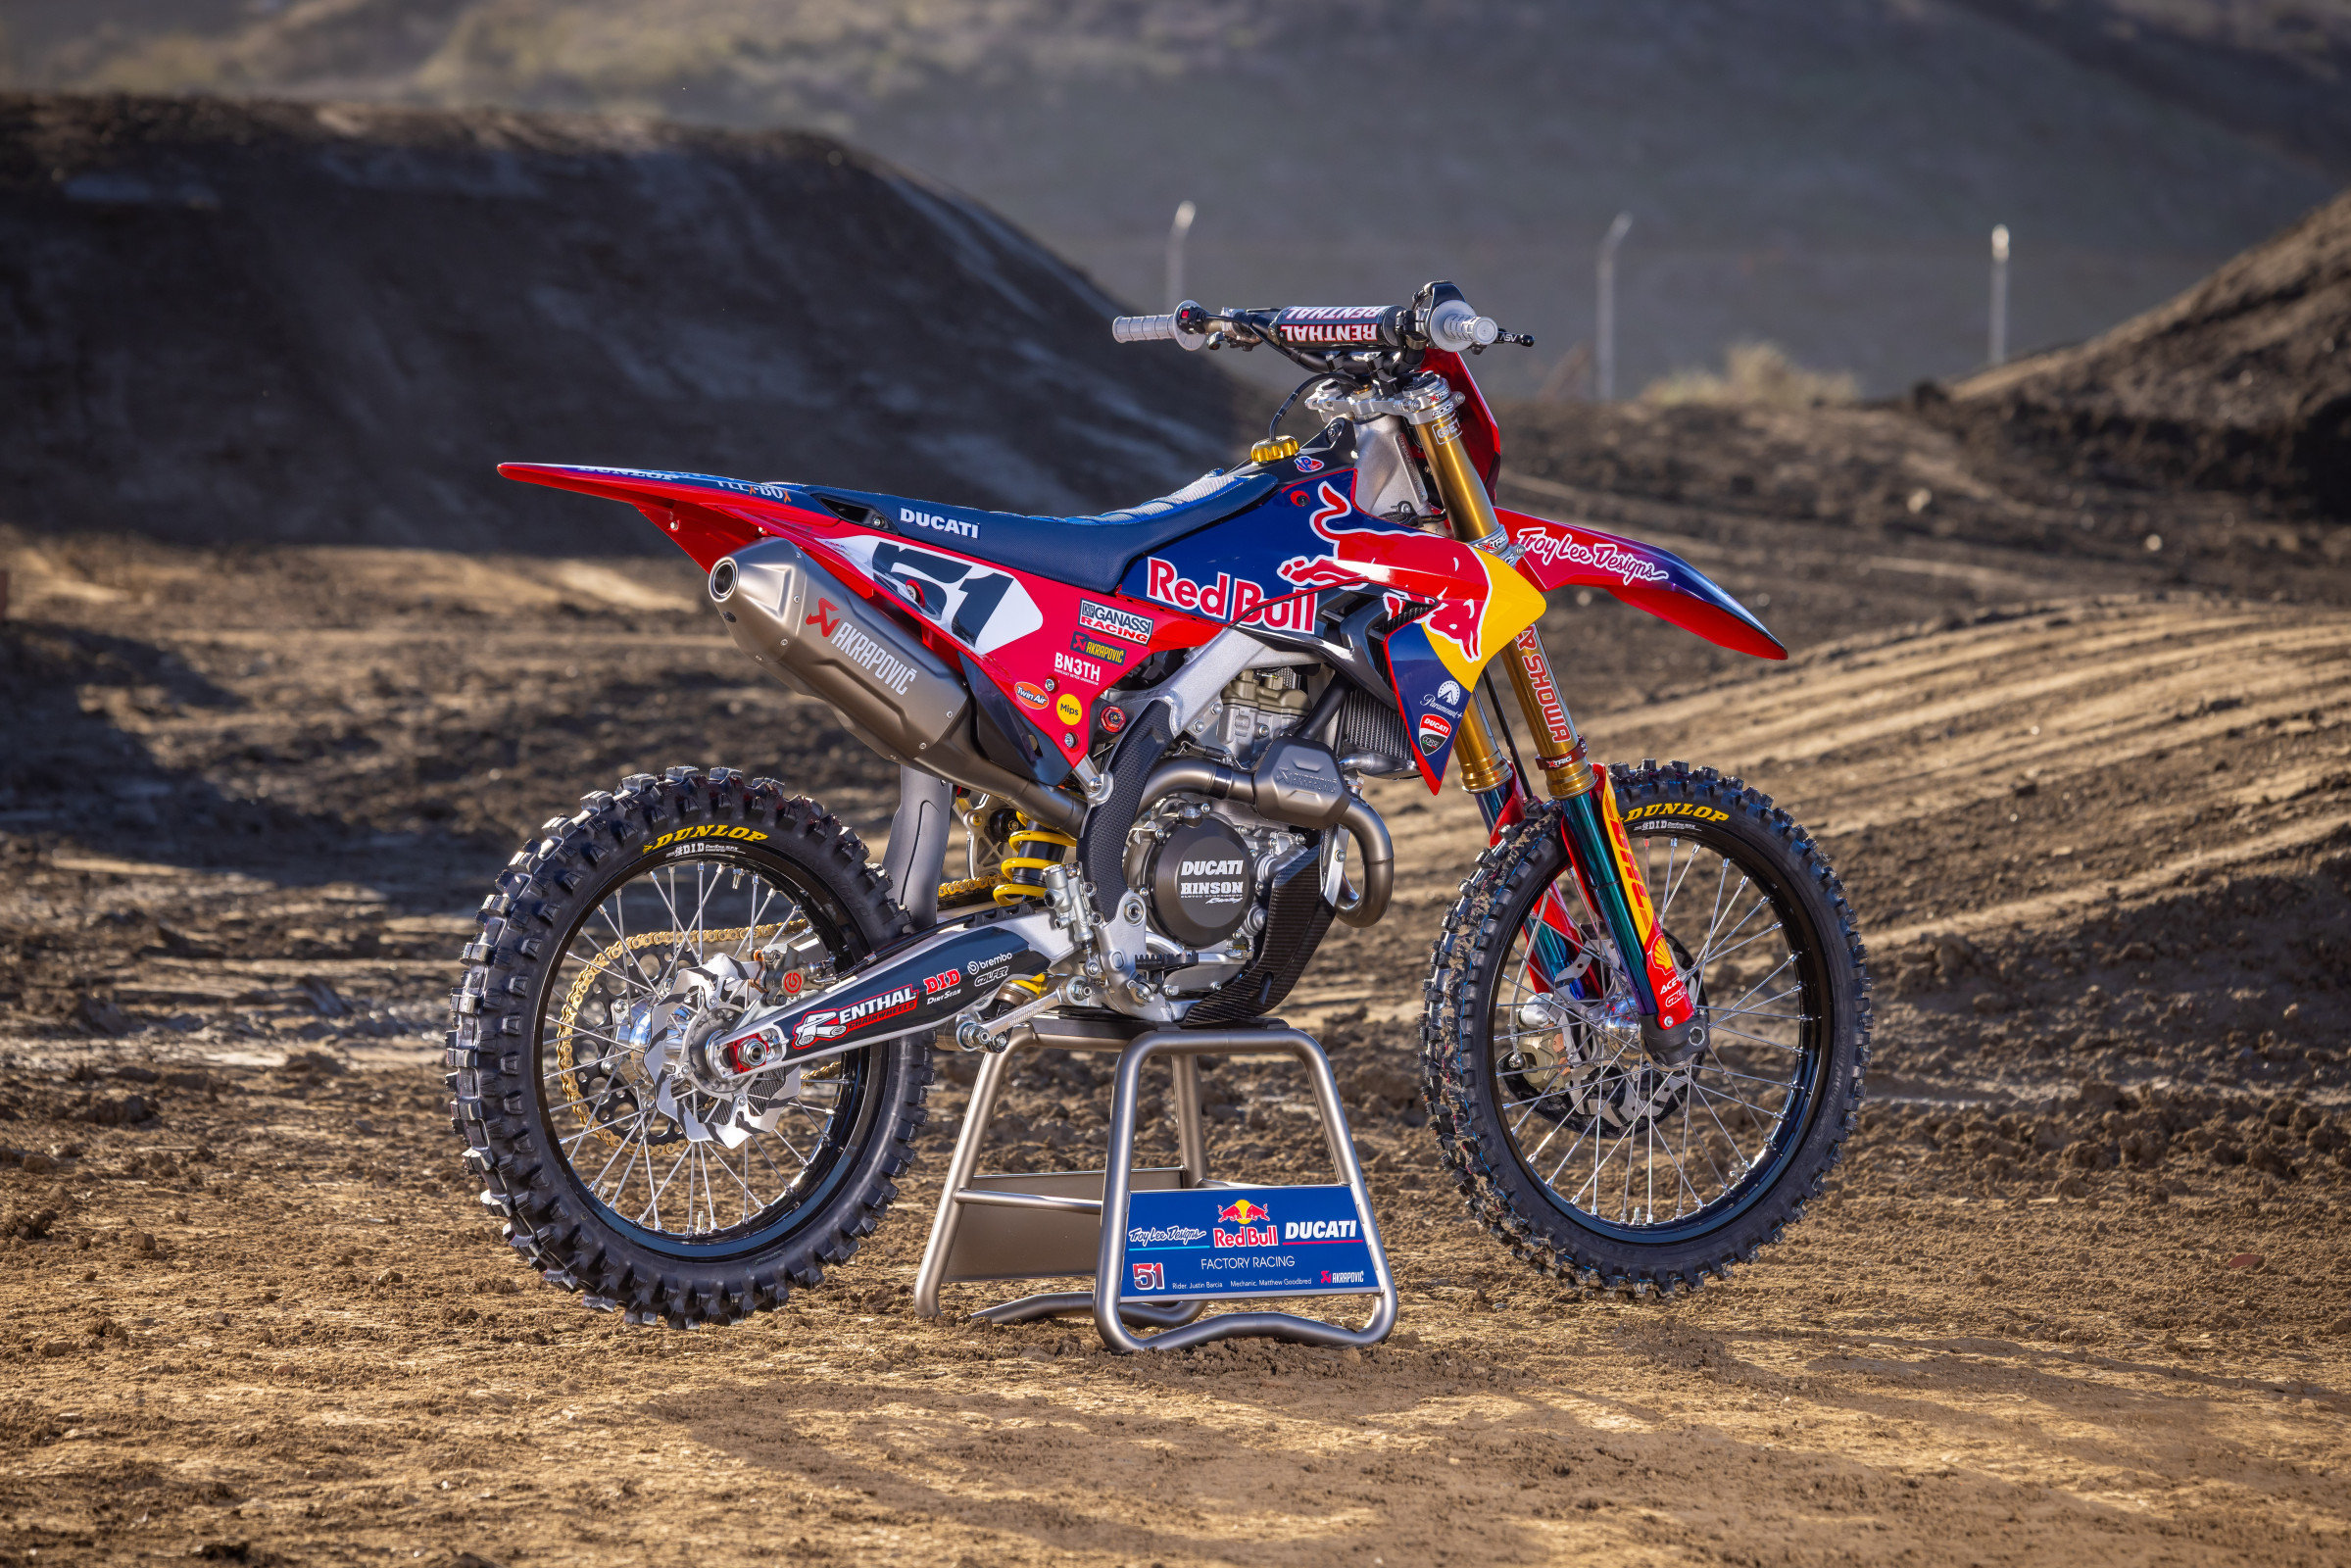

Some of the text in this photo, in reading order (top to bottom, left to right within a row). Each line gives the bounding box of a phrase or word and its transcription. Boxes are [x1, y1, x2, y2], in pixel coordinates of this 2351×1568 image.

[1281, 323, 1378, 342] RENTHAL
[1499, 333, 1517, 342] ASV
[1432, 401, 1454, 418] ROCS
[900, 507, 979, 539] DUCATI
[1478, 533, 1508, 553] XTRIG
[1517, 526, 1670, 586] Troy Lee Designs
[871, 541, 1015, 649] 51
[1147, 556, 1318, 635] Red Bull
[1081, 615, 1149, 643] RACING
[1095, 607, 1151, 634] GANASSI
[1054, 652, 1101, 682] BN3TH
[1016, 685, 1048, 706] Twin Air
[1522, 654, 1571, 744] SHOWA
[1060, 703, 1079, 716] Mips
[1424, 717, 1449, 734] DUCATI
[1546, 755, 1573, 768] XTRIG
[1624, 803, 1730, 823] DUNLOP
[652, 824, 769, 850] DUNLOP
[1181, 860, 1244, 876] DUCATI
[1181, 881, 1244, 895] HINSON
[978, 952, 1013, 969] brembo
[793, 987, 917, 1047] RENTHAL
[849, 1002, 915, 1029] CHAINWHEELS
[1129, 1219, 1357, 1249] Troy Lee Designs Red Bull DUCATI
[1200, 1255, 1296, 1270] FACTORY RACING
[1133, 1262, 1165, 1290] 51
[1283, 1277, 1312, 1286] Goodbred
